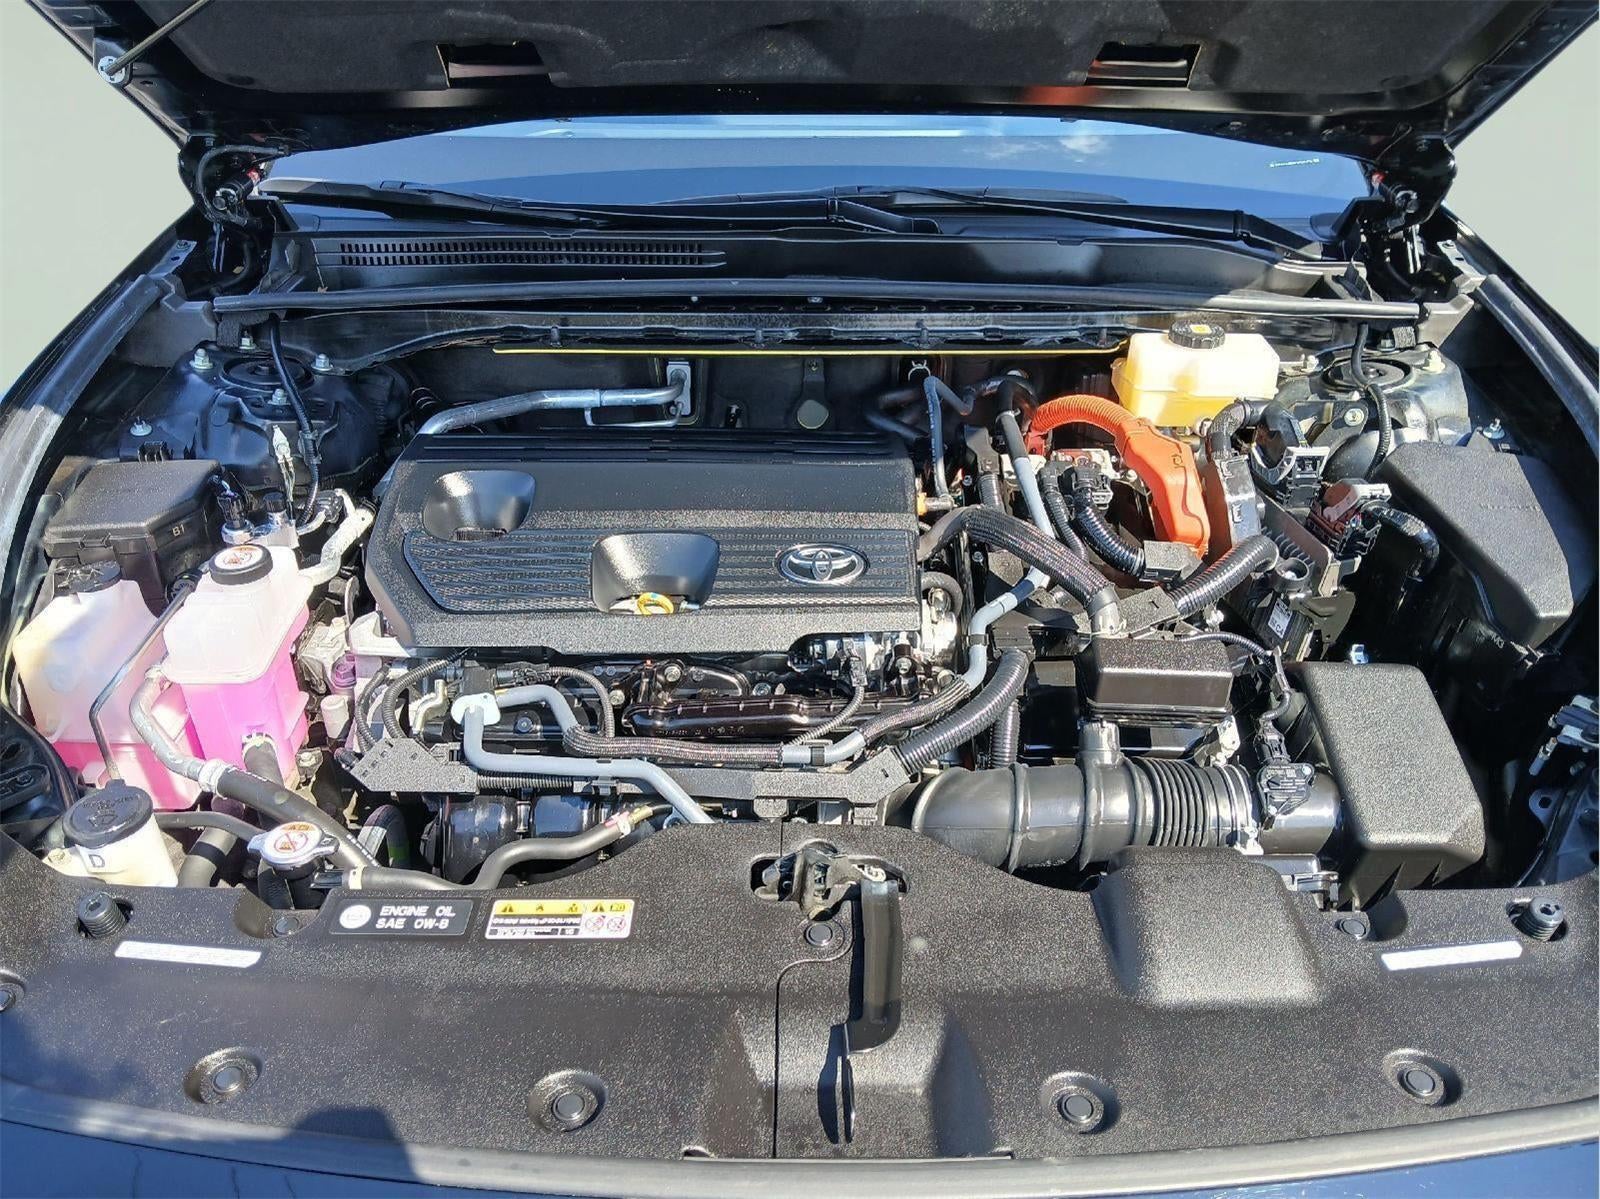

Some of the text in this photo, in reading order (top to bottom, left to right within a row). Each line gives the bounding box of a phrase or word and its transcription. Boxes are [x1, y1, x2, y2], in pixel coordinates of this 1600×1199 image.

[172, 524, 185, 536] B1
[88, 854, 105, 868] D
[380, 906, 456, 918] ENGINE OIL
[375, 917, 407, 929] SAE
